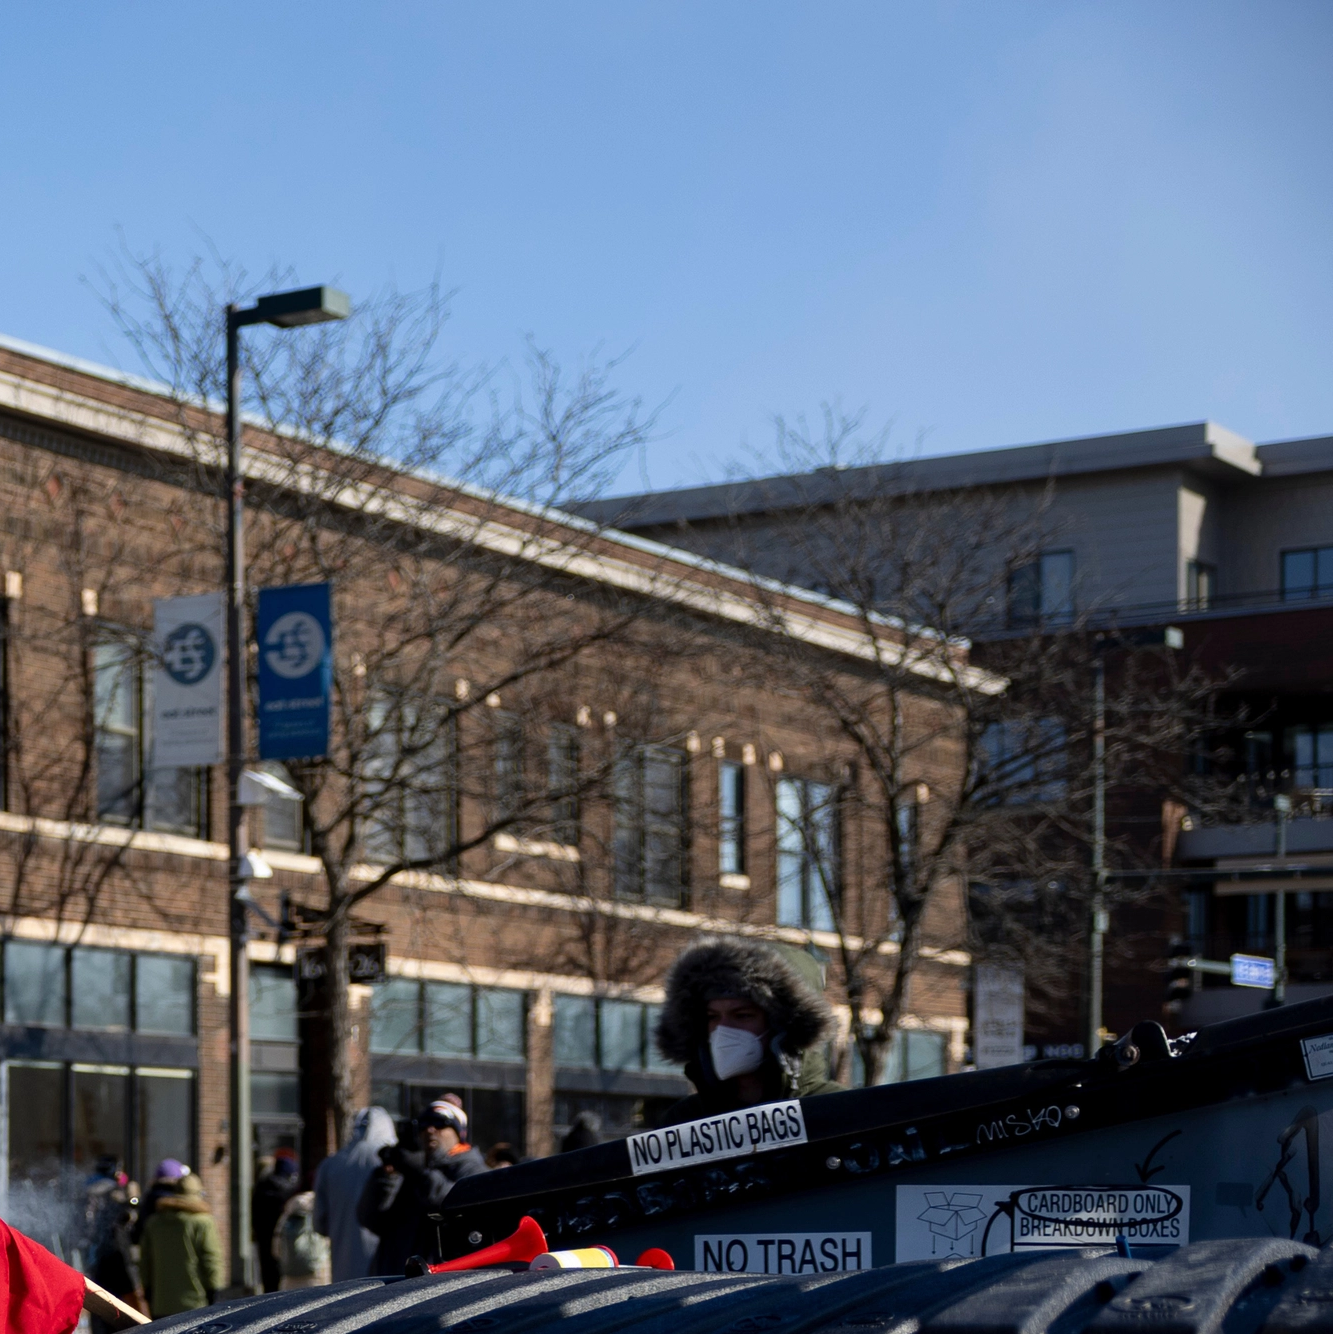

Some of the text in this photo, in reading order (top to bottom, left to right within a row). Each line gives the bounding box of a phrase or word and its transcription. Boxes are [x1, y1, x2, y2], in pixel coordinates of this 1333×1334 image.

[632, 1105, 801, 1167] NO PLASTIC BAGS
[1027, 1193, 1175, 1214] CARDBOARD ONLY
[1020, 1217, 1180, 1238] BREAKDOWN BOXES
[703, 1237, 862, 1274] NO TRASH
